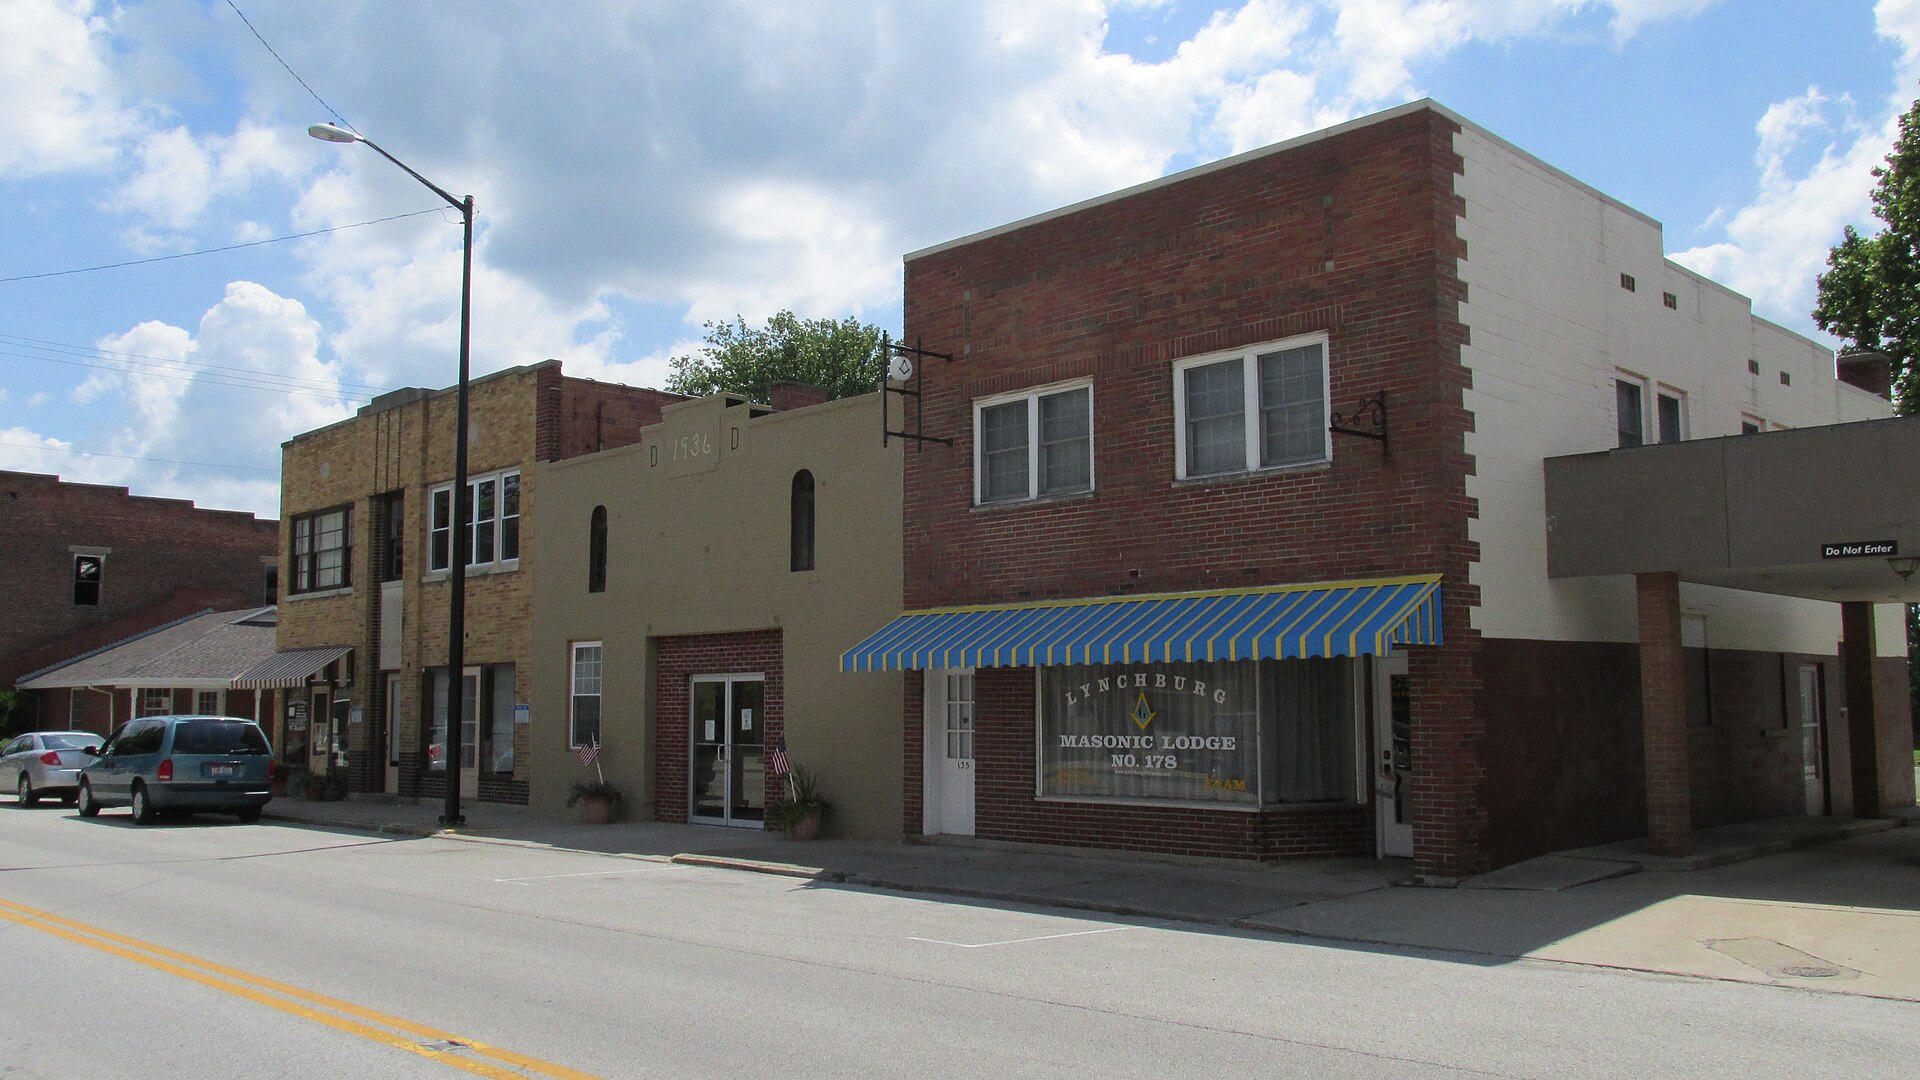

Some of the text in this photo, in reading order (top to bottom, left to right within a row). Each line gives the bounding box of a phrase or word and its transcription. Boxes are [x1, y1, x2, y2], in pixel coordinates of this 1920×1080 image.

[673, 433, 711, 461] 1936
[1825, 544, 1893, 556] Do Not Enter
[1065, 673, 1227, 706] LYNCHBURG
[1059, 734, 1236, 751] MASONIC LODGE
[957, 760, 970, 770] 135
[1111, 754, 1178, 769] NO. 178
